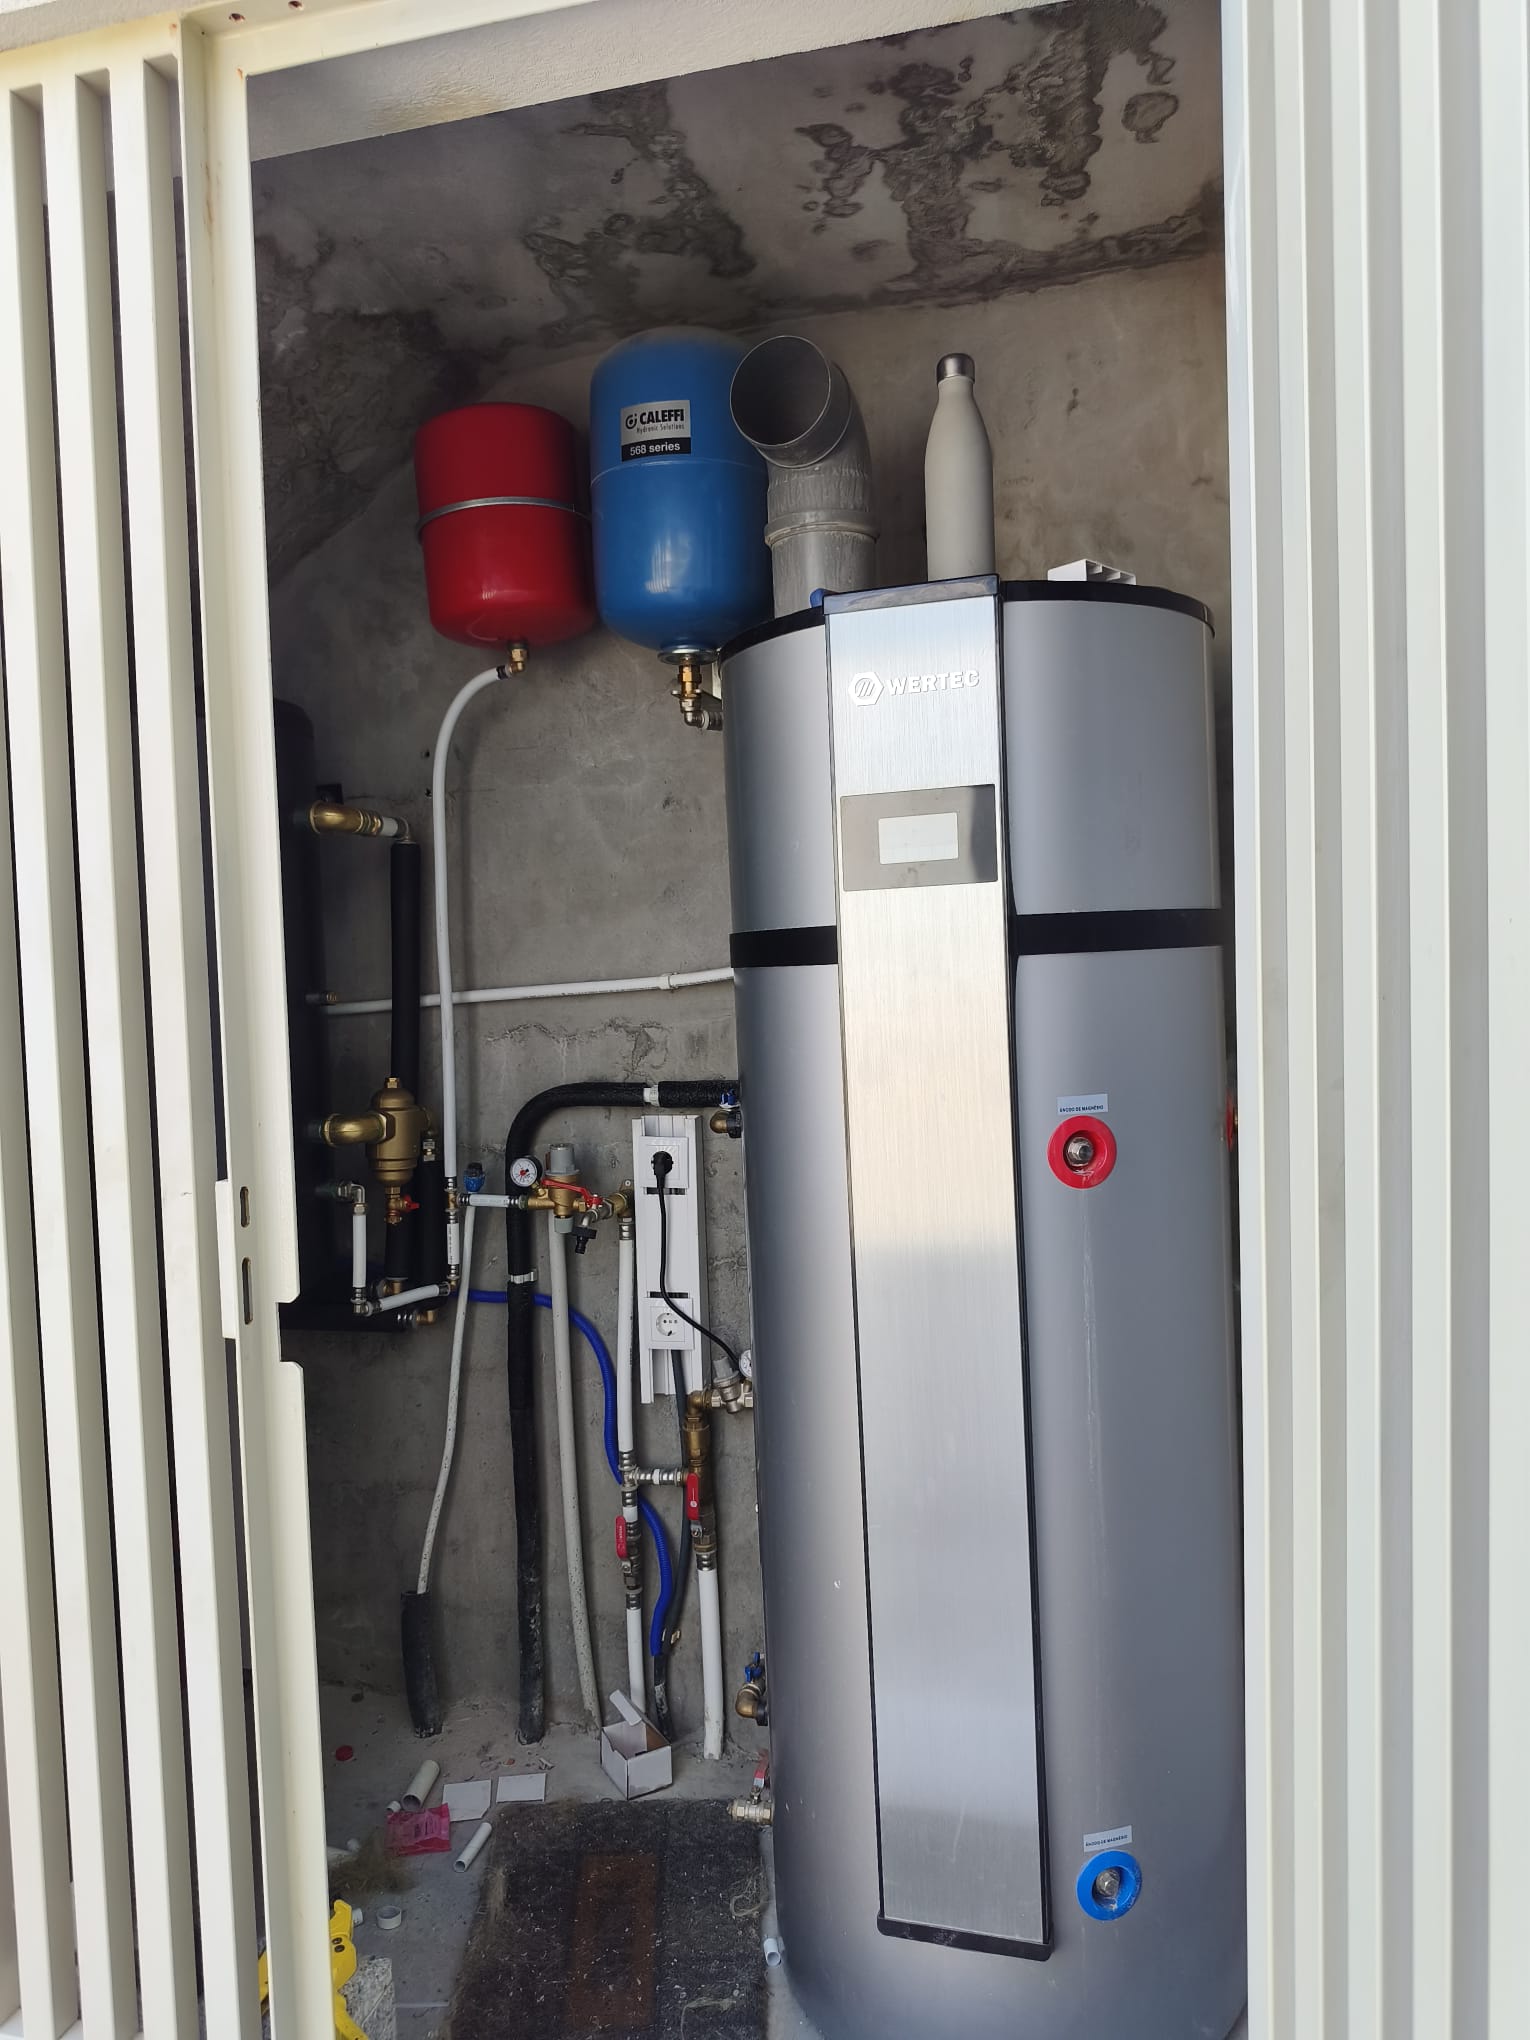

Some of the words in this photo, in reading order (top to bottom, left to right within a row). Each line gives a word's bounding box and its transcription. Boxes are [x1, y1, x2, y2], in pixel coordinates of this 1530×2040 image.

[640, 409, 684, 425] CALEFFI
[637, 426, 658, 434] Hydronic
[660, 423, 684, 431] Solutions
[630, 445, 647, 456] 568
[649, 442, 680, 453] series
[887, 670, 980, 696] WERTEC
